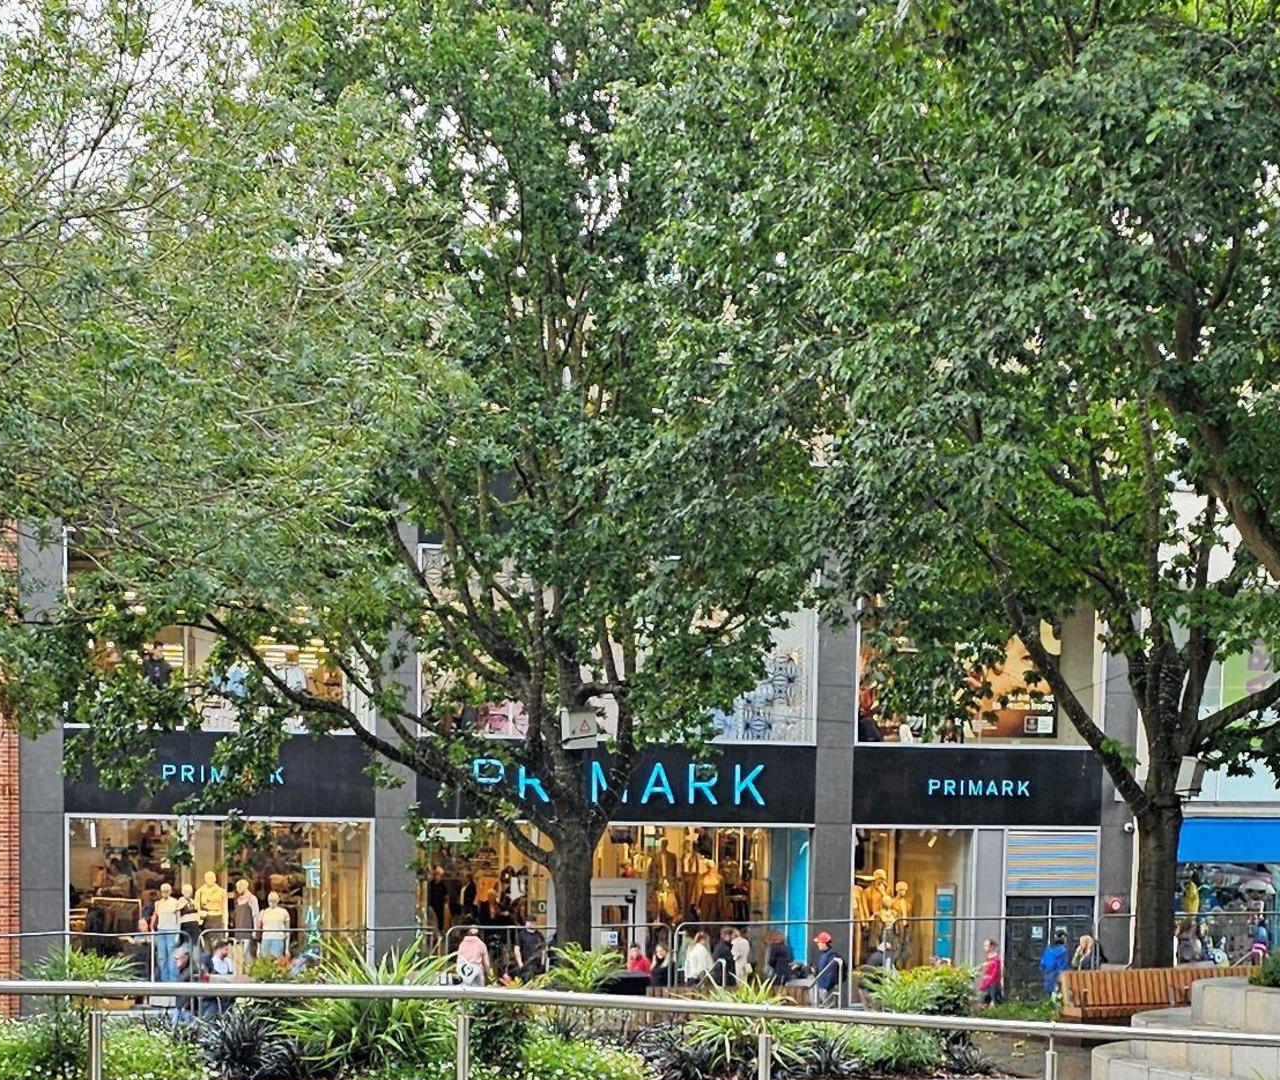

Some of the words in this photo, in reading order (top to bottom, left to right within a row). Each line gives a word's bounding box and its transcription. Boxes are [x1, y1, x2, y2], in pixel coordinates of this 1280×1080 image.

[162, 764, 284, 784] PRIMK
[472, 757, 766, 806] PRMARK
[927, 778, 1030, 797] PRIMARK
